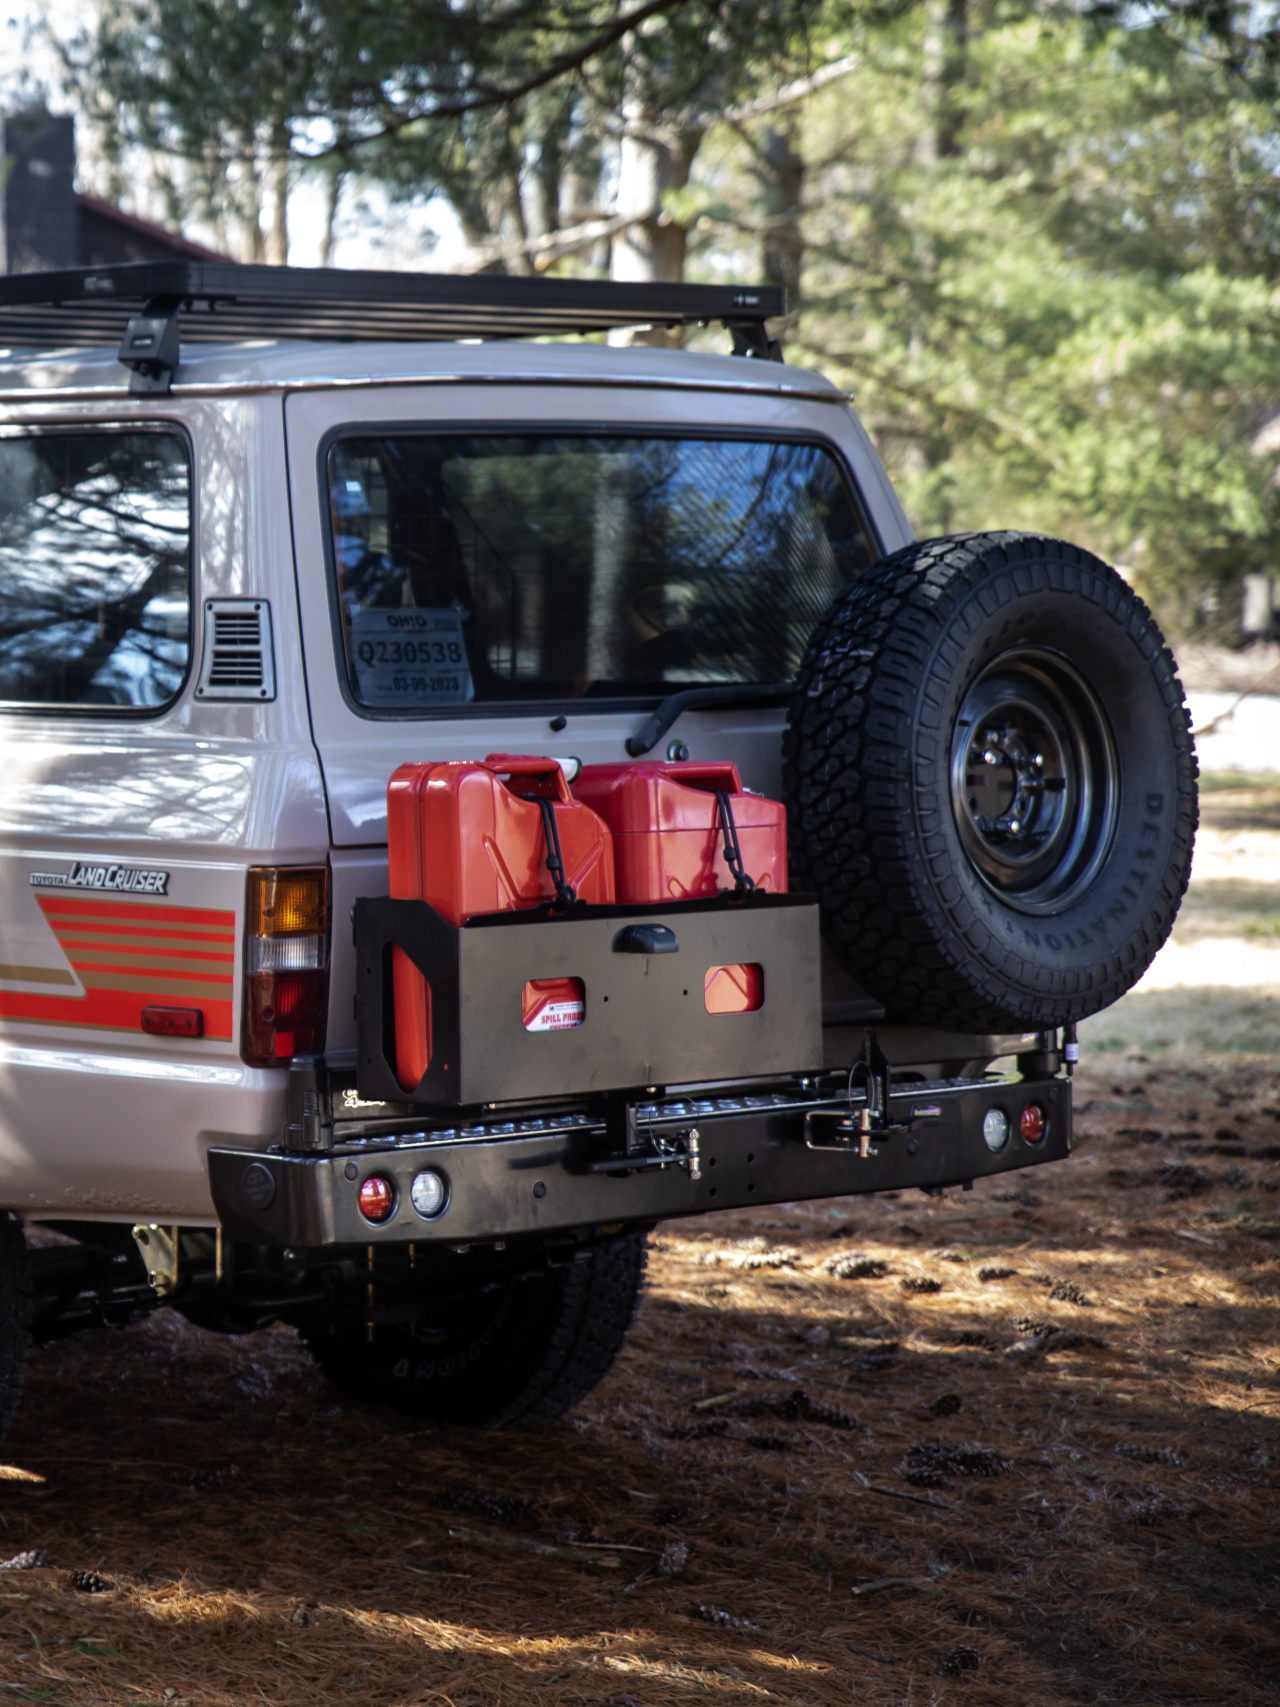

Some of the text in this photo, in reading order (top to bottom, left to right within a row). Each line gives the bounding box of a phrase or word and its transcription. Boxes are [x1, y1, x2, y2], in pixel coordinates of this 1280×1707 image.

[386, 615, 426, 628] OHIO
[357, 640, 462, 669] Q230538
[1024, 792, 1164, 951] DESTINATION
[31, 874, 64, 885] TOYOTA
[541, 1013, 561, 1024] SPILL
